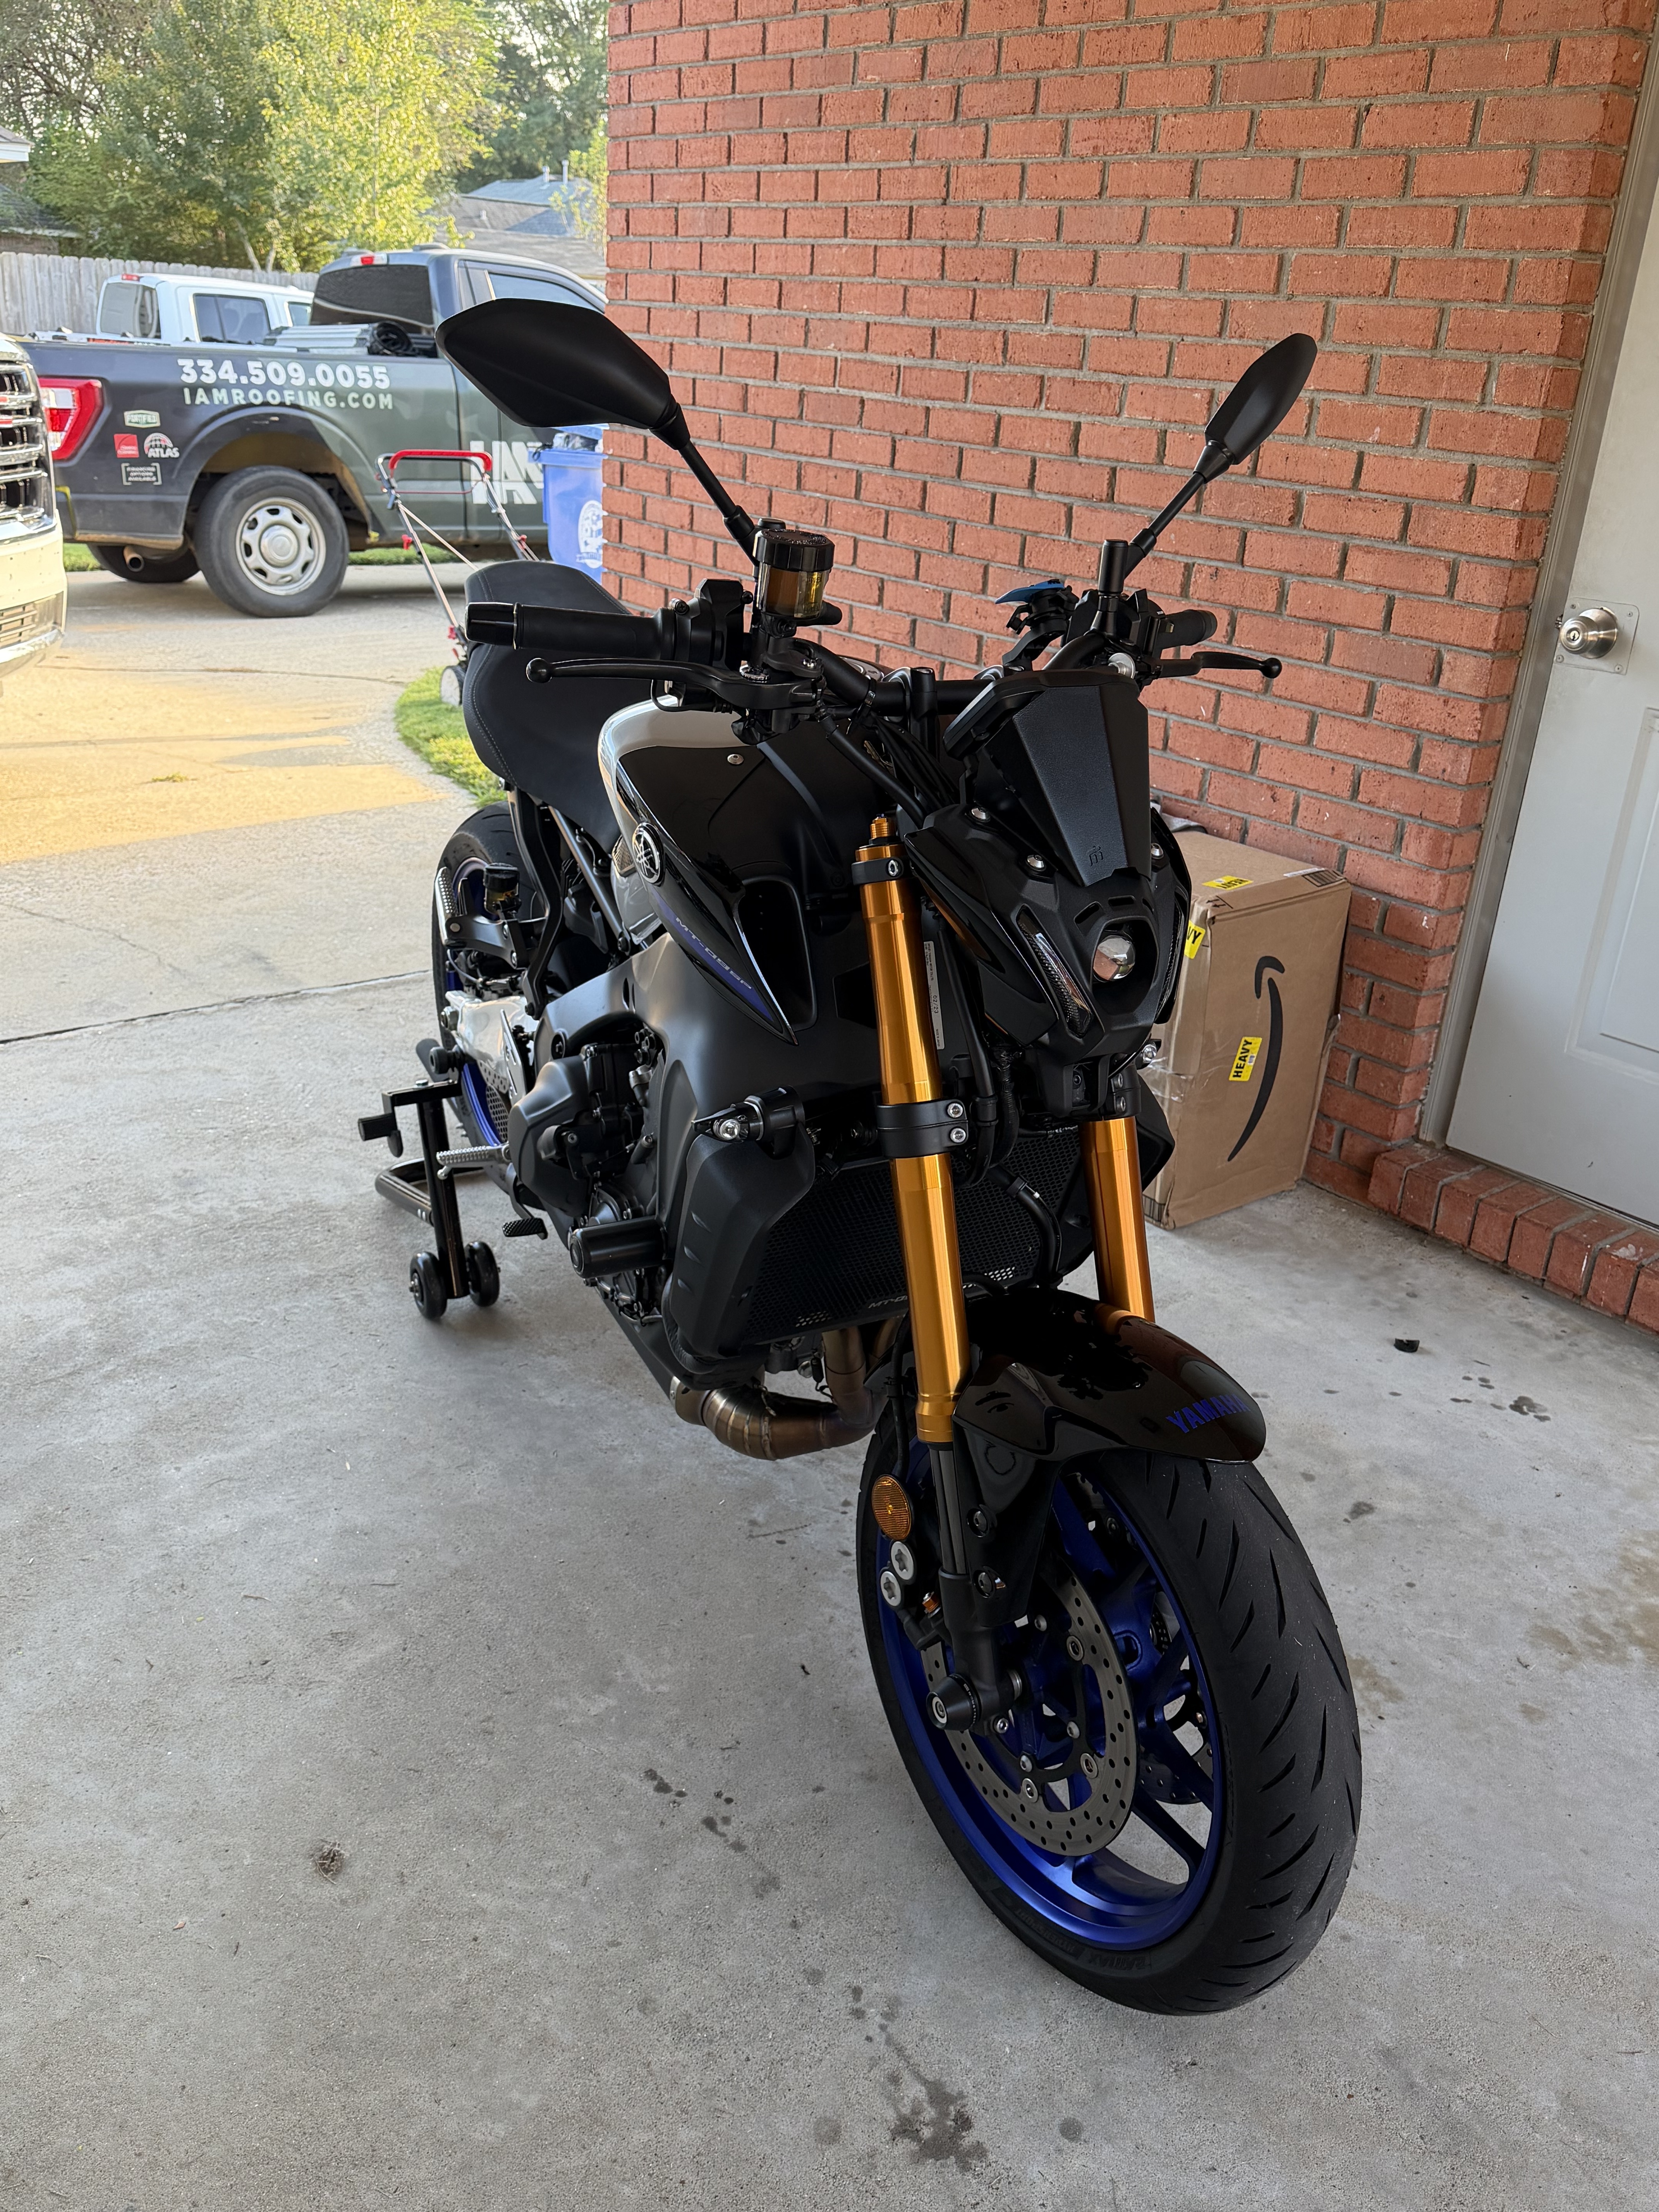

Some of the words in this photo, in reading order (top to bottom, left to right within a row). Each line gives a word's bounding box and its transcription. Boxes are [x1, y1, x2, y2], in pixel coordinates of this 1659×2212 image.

[177, 359, 390, 389] 334.509.0055
[183, 388, 393, 409] IAMROOFING.COM
[148, 447, 180, 458] ATLAS
[1232, 1039, 1252, 1078] HEAVY
[1166, 1394, 1251, 1433] YAMAHA
